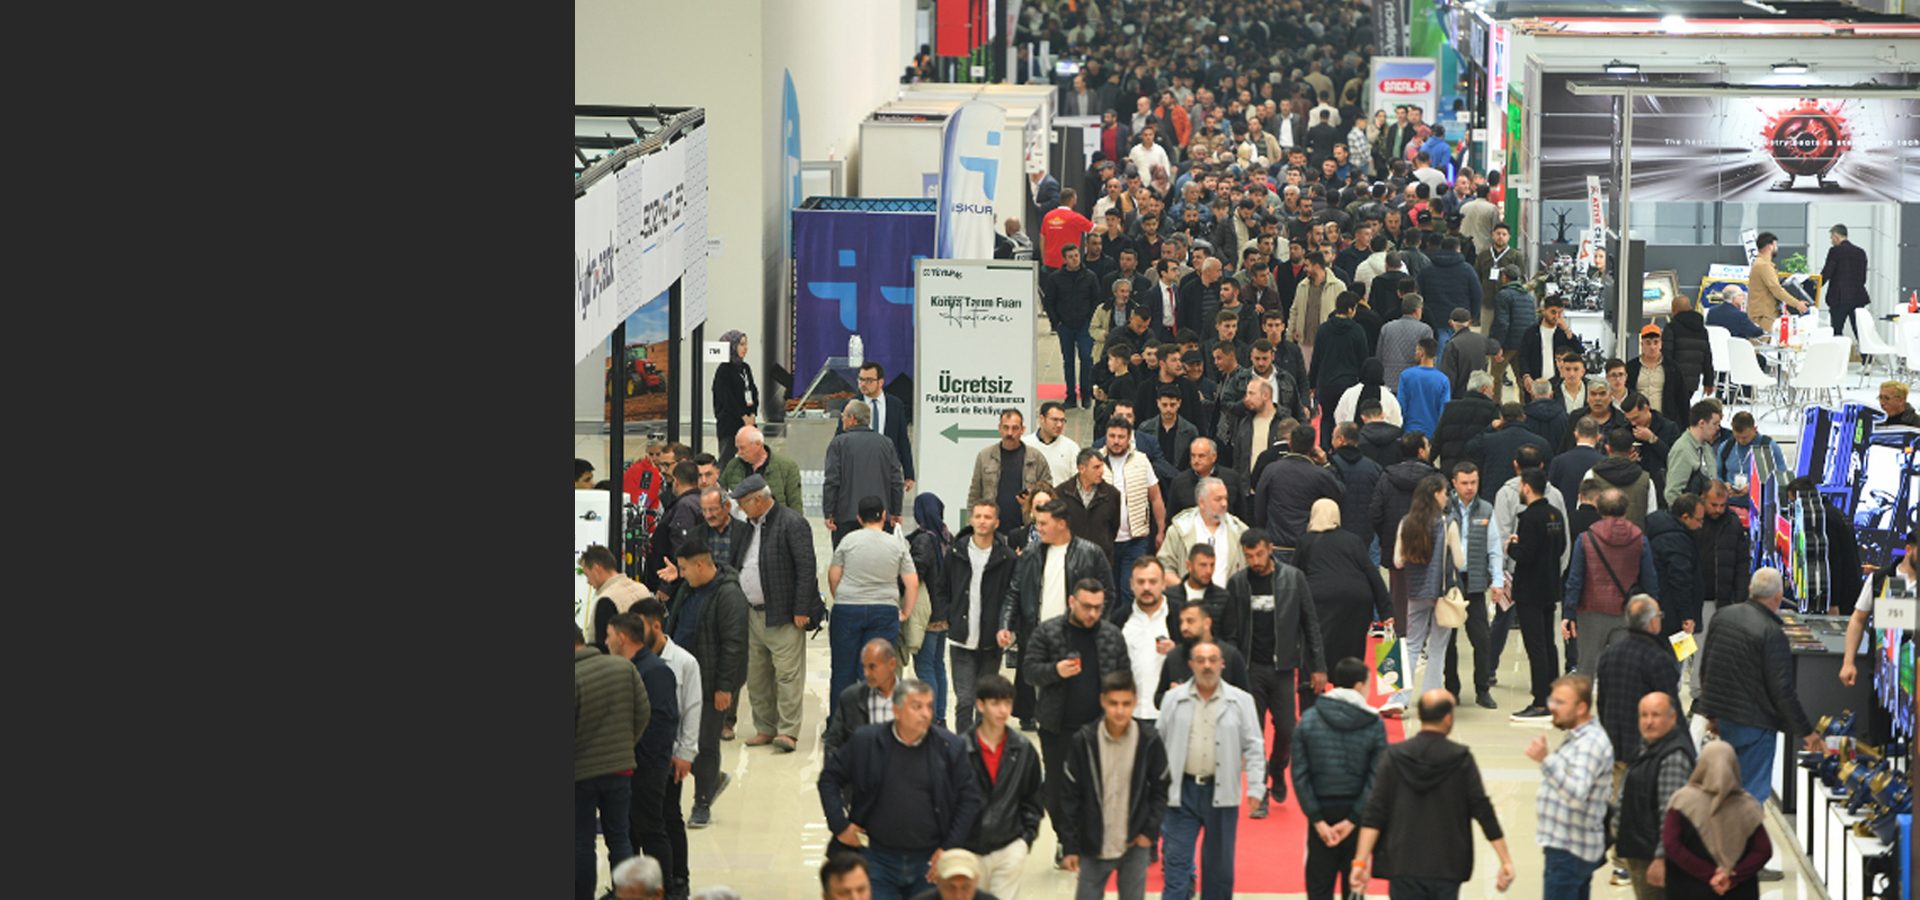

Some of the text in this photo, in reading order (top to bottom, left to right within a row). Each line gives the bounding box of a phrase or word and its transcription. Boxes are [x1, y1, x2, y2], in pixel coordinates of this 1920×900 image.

[930, 296, 962, 309] Konya
[964, 297, 994, 308] Tarım
[939, 370, 1013, 393] Ücretsiz
